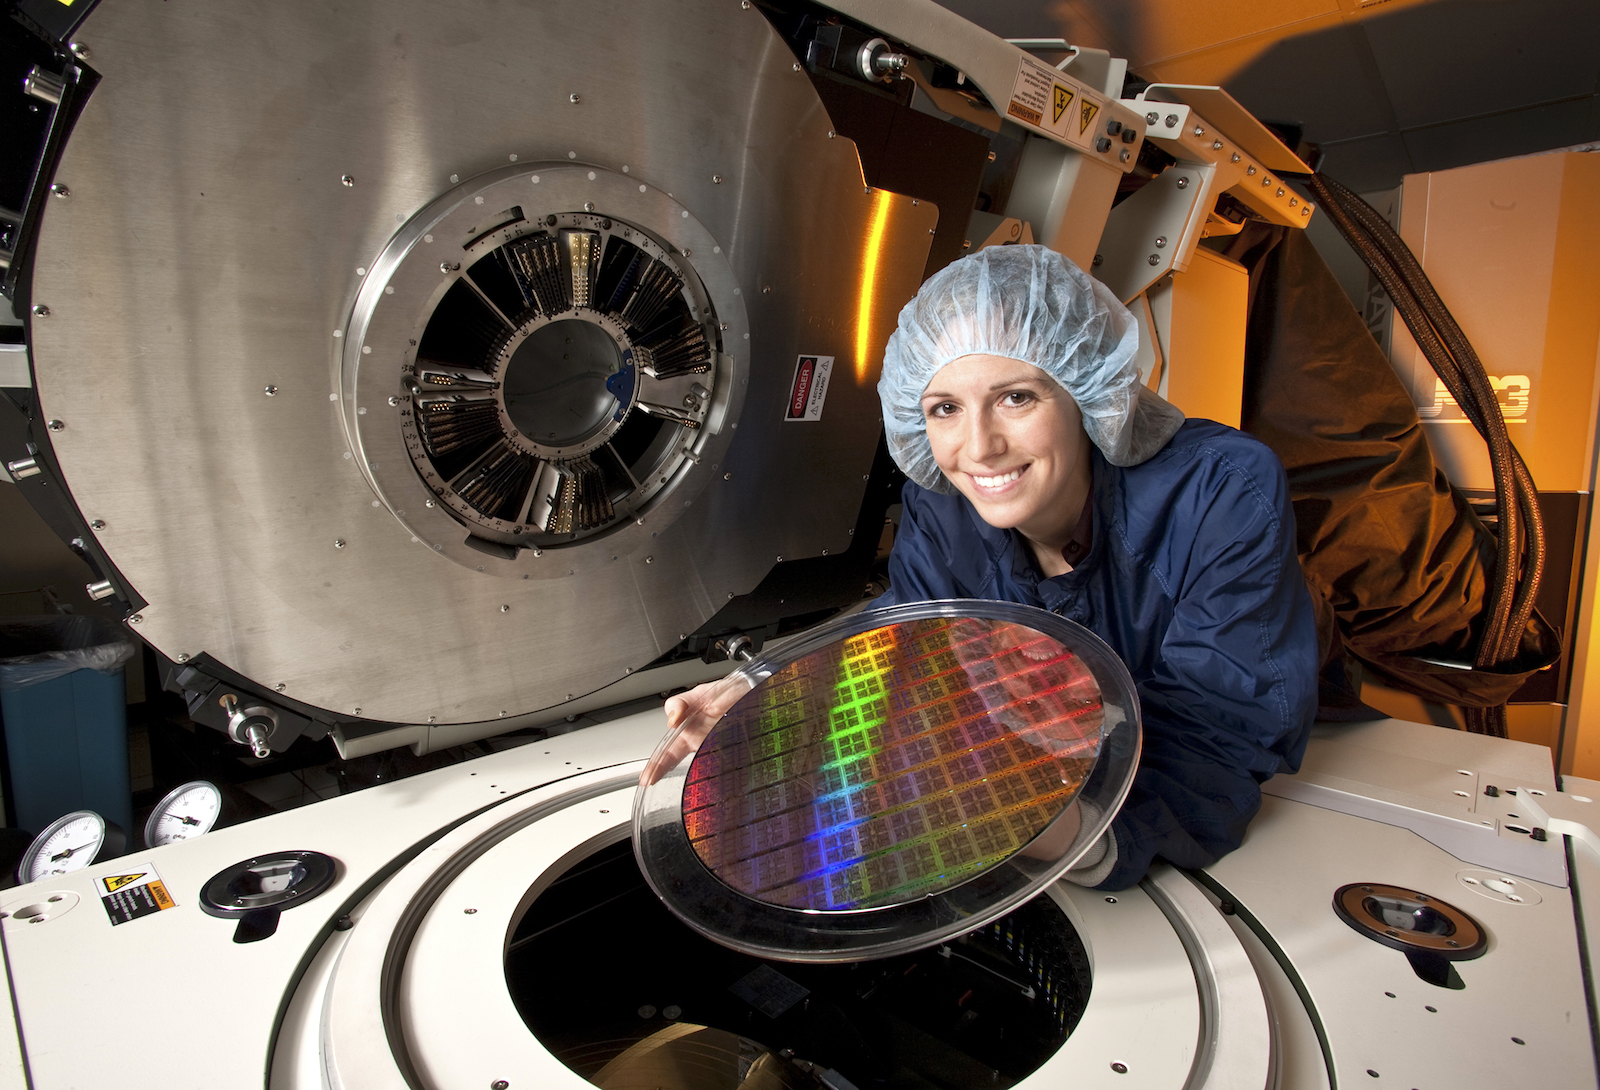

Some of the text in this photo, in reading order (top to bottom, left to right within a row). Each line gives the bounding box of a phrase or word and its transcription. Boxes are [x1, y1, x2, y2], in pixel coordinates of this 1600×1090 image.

[1011, 104, 1034, 120] WARNING
[795, 369, 809, 409] DANGER
[812, 372, 822, 404] ELECTRICAL
[818, 377, 826, 399] HAZARD
[155, 886, 169, 904] WARNING
